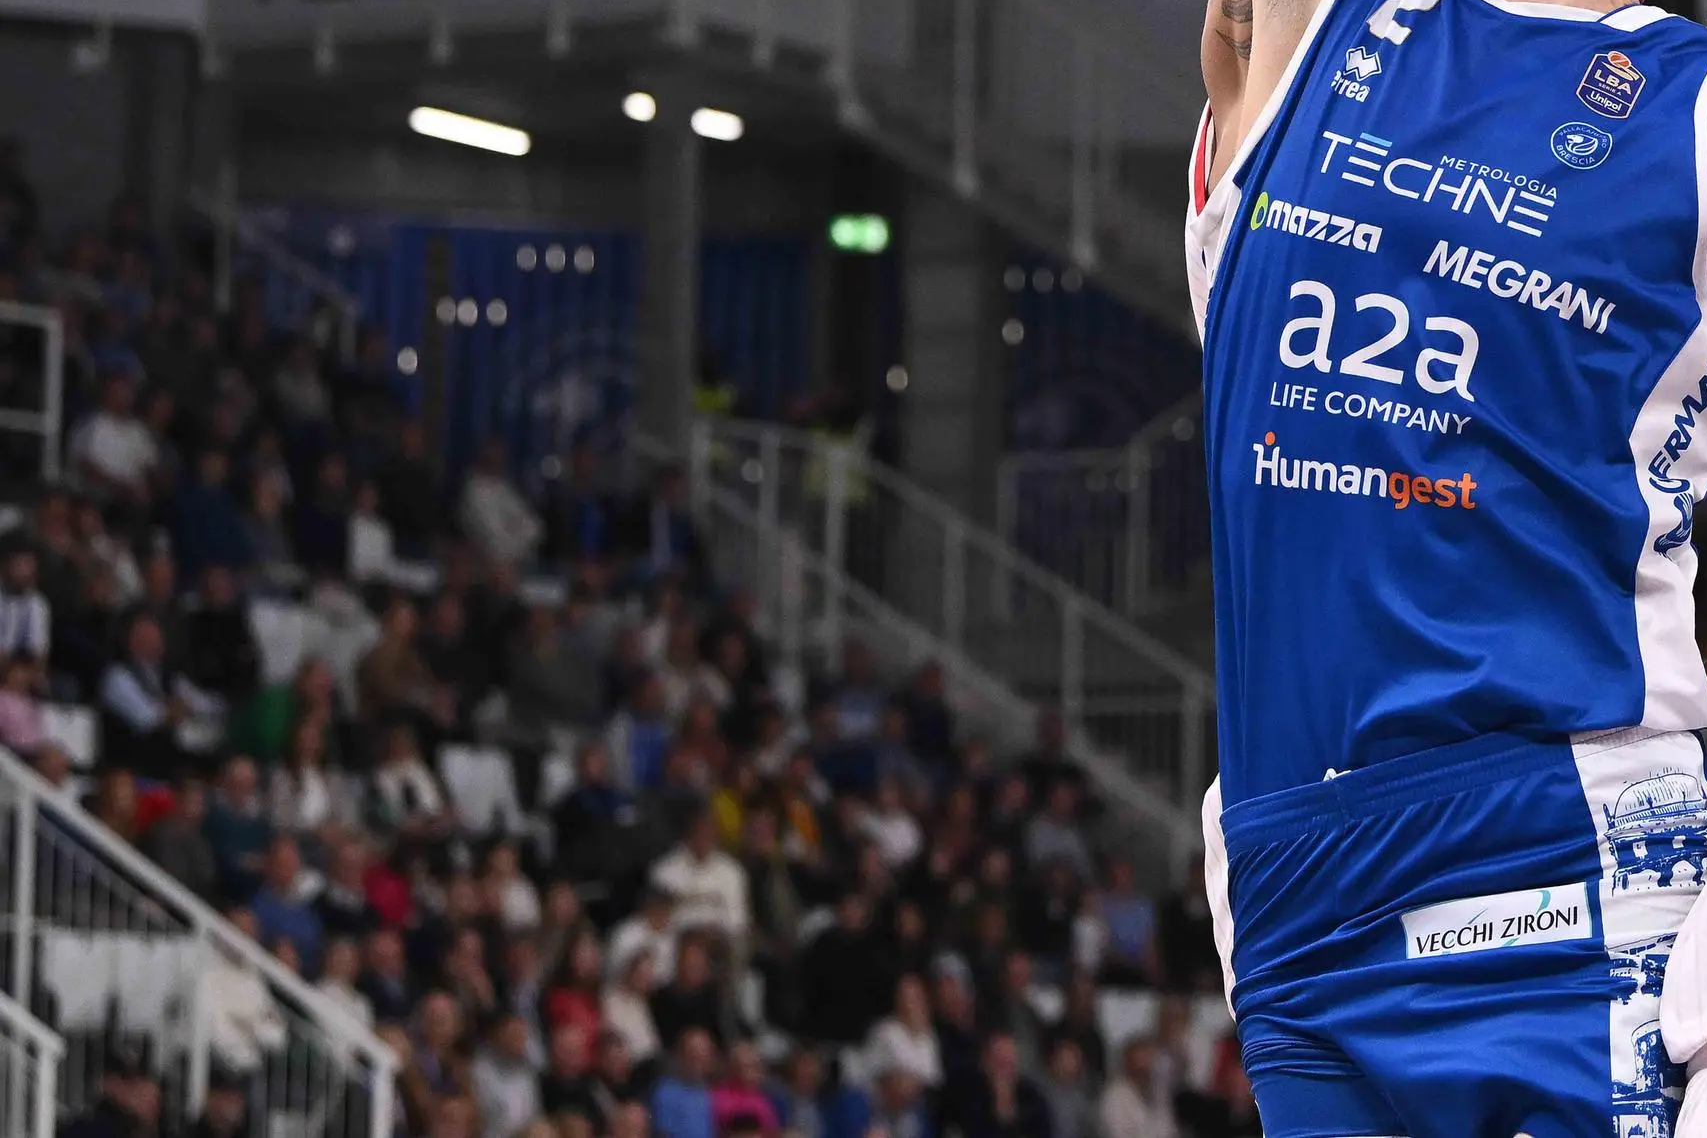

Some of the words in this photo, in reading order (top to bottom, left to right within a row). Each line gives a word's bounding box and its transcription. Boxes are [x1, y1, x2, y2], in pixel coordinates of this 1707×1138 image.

[1590, 90, 1622, 112] Unipol
[1594, 68, 1632, 96] LBA
[1598, 82, 1616, 93] SERIE
[1440, 155, 1558, 199] METROLOGIA
[1556, 144, 1596, 166] BRESCIA
[1320, 130, 1556, 238] TECHNE
[1422, 240, 1616, 334] MEGRANI
[1279, 279, 1479, 402] a2a
[1270, 381, 1318, 411] LIFE
[1324, 391, 1472, 435] COMPANY
[1253, 431, 1478, 510] Humangest
[1415, 921, 1493, 955] VECCHI
[1500, 905, 1579, 940] ZIRONI
